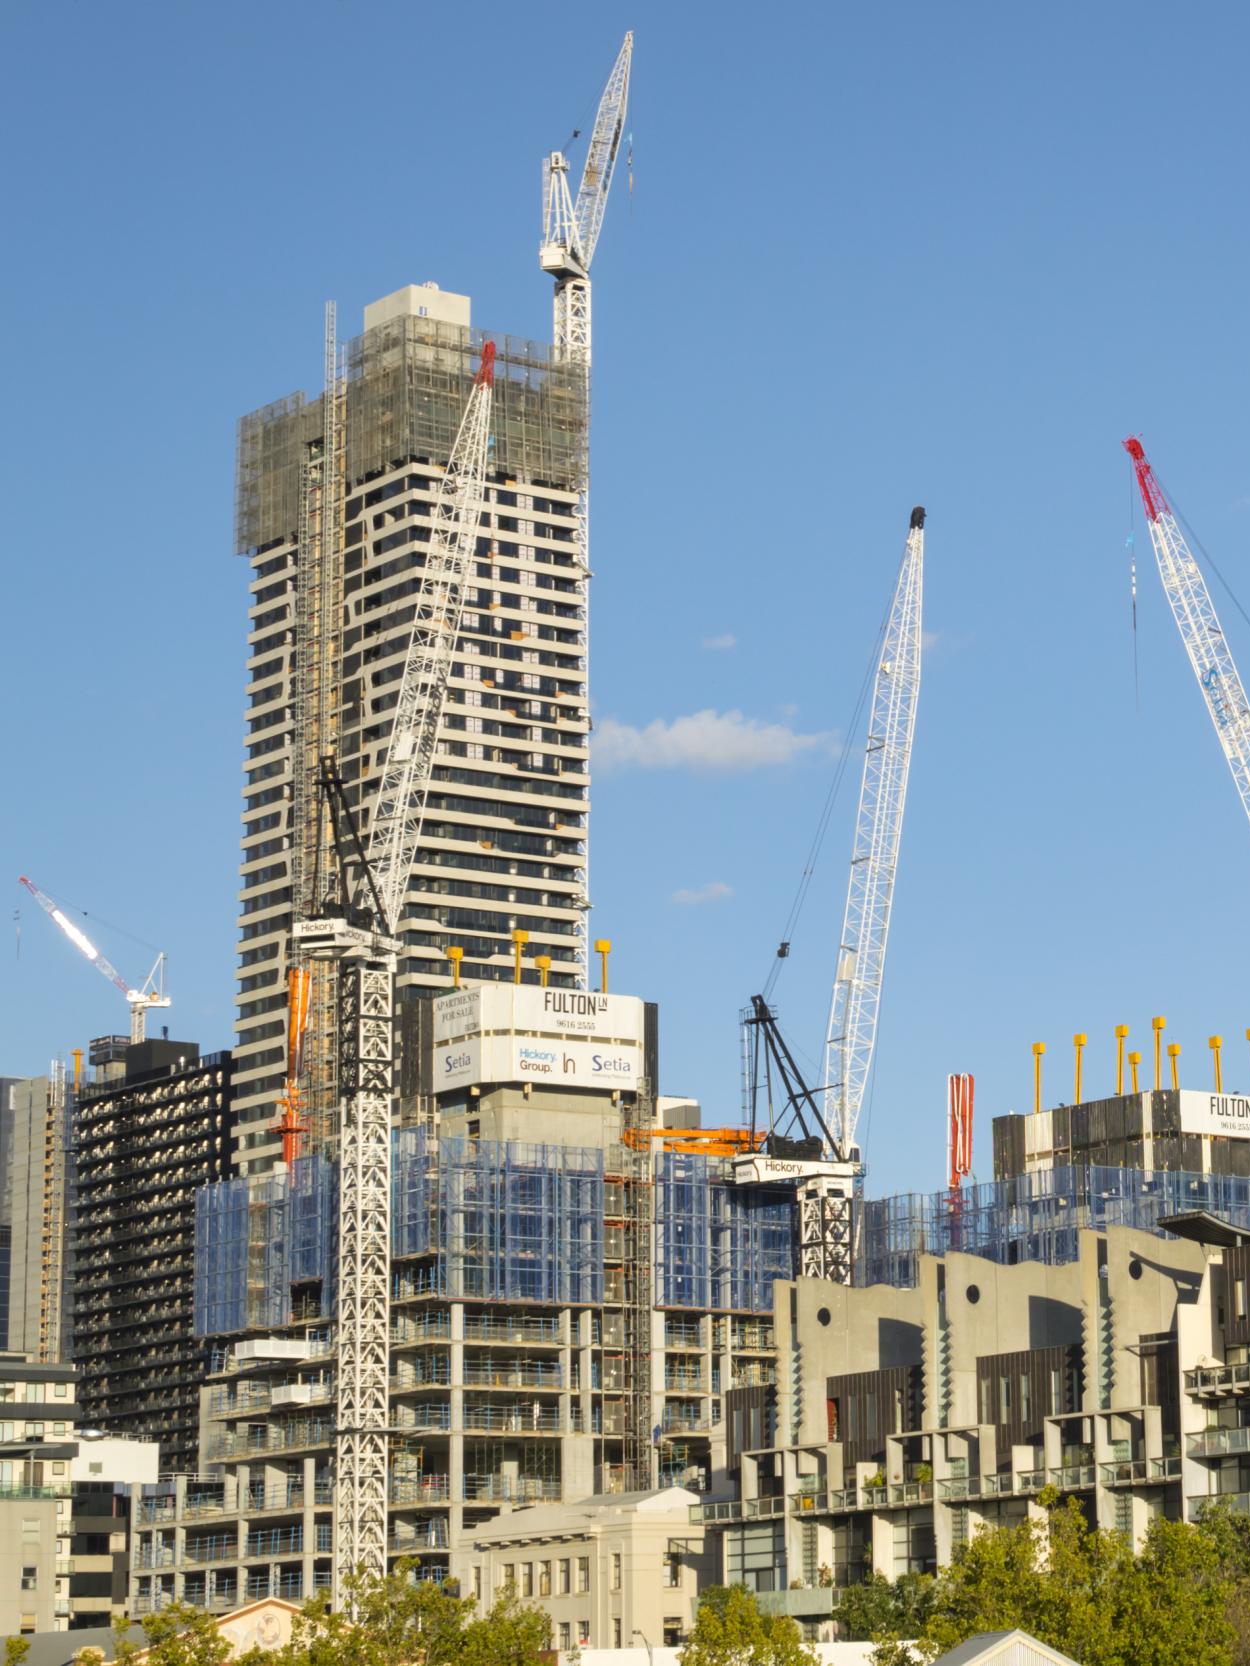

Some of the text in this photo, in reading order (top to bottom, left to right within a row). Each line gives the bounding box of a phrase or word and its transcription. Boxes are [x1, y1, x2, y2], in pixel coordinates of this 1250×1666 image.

[436, 992, 480, 1011] APARTMENTS
[545, 992, 608, 1016] FULTON LN
[441, 1006, 473, 1023] FOR SALE
[556, 1020, 576, 1029] 9616
[445, 1052, 471, 1073] Setia
[520, 1060, 553, 1074] Group.
[592, 1055, 631, 1072] Setia
[765, 1160, 804, 1175] Hickory.
